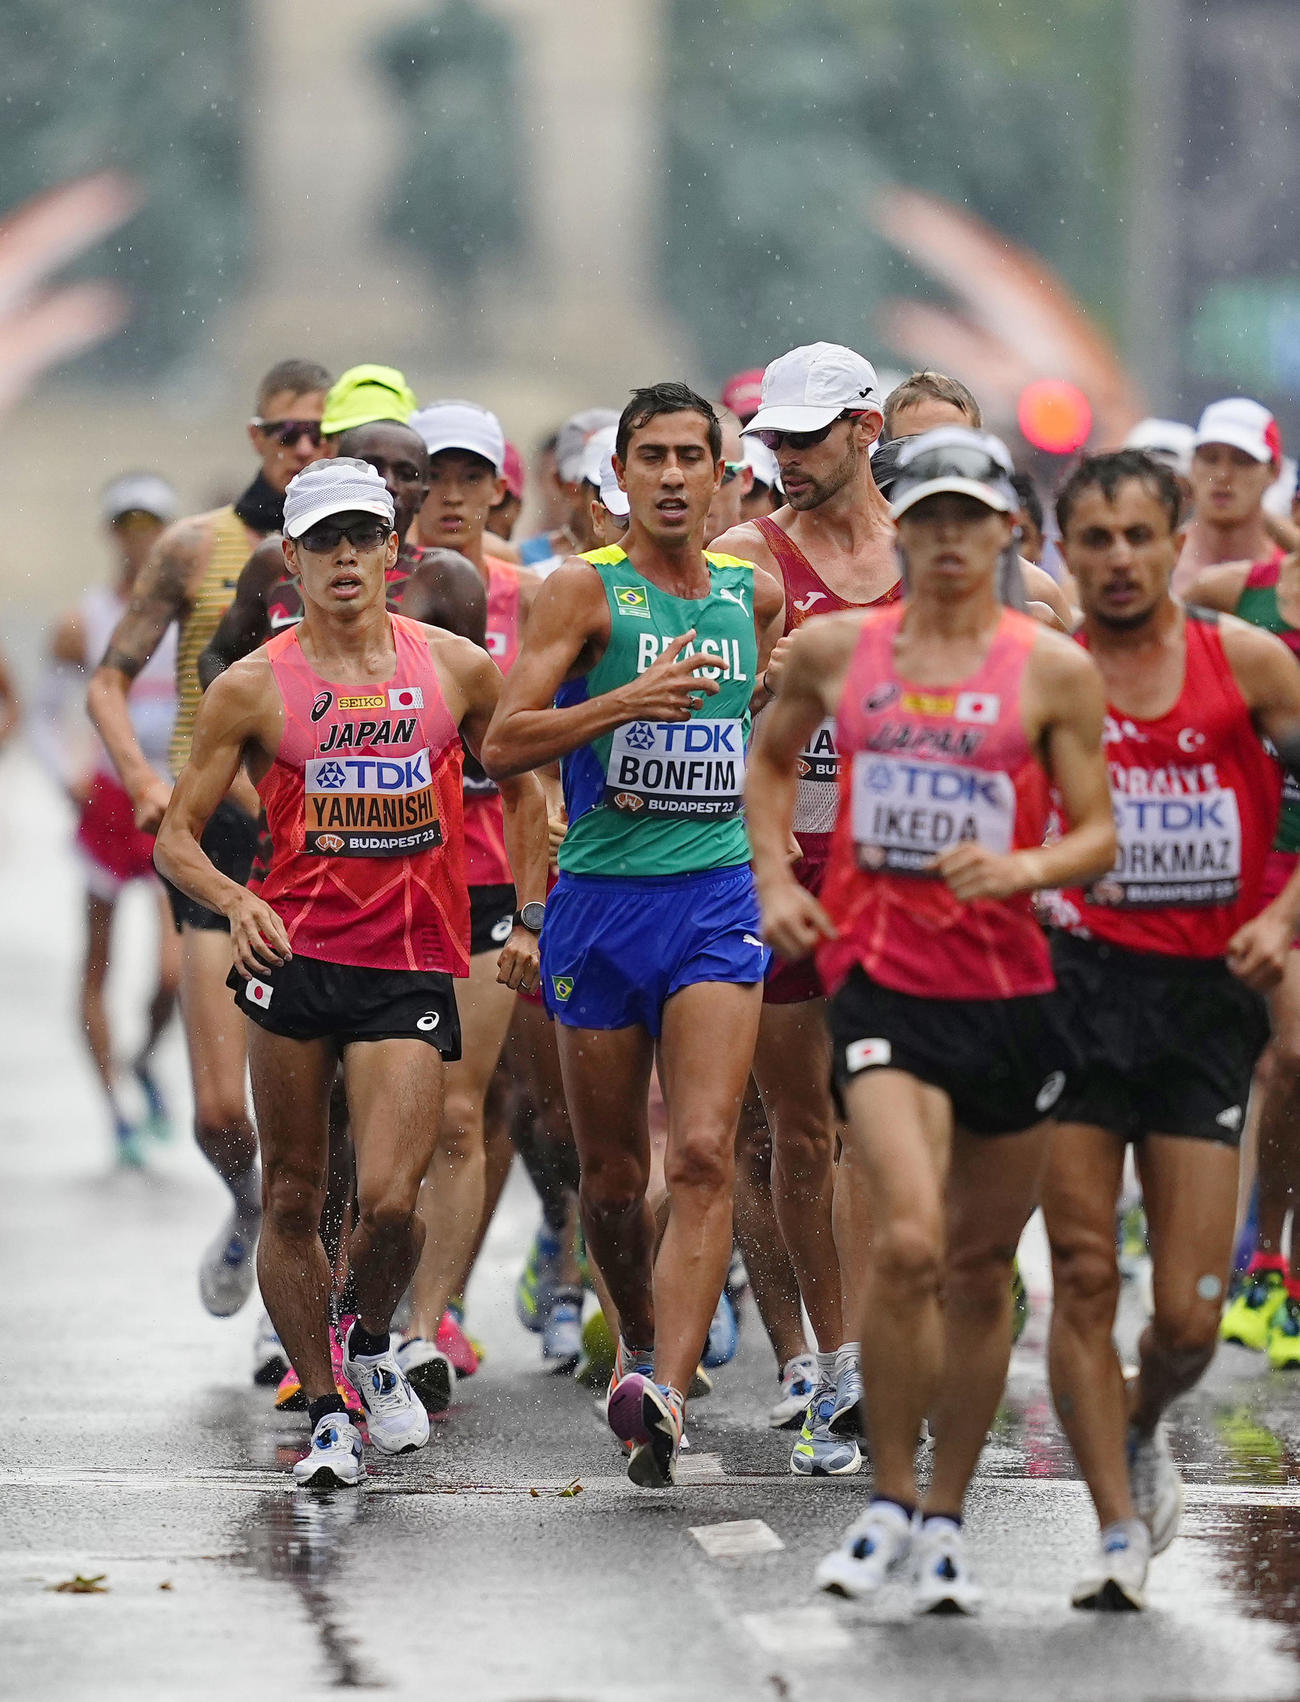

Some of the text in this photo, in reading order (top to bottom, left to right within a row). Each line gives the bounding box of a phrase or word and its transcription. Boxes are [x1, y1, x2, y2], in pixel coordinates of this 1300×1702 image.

[339, 696, 384, 709] SEIKO
[319, 718, 416, 752] JAPAN
[657, 723, 735, 752] TDK
[345, 755, 426, 789] TDK
[618, 755, 736, 791] BONFIM
[899, 766, 1003, 806] TDK
[312, 788, 433, 829] YAMANISHI
[648, 799, 734, 814] BUDAPEST 23
[1127, 799, 1225, 830] TDK
[349, 829, 435, 849] BUDAPEST 23
[873, 806, 979, 844] IKEDA
